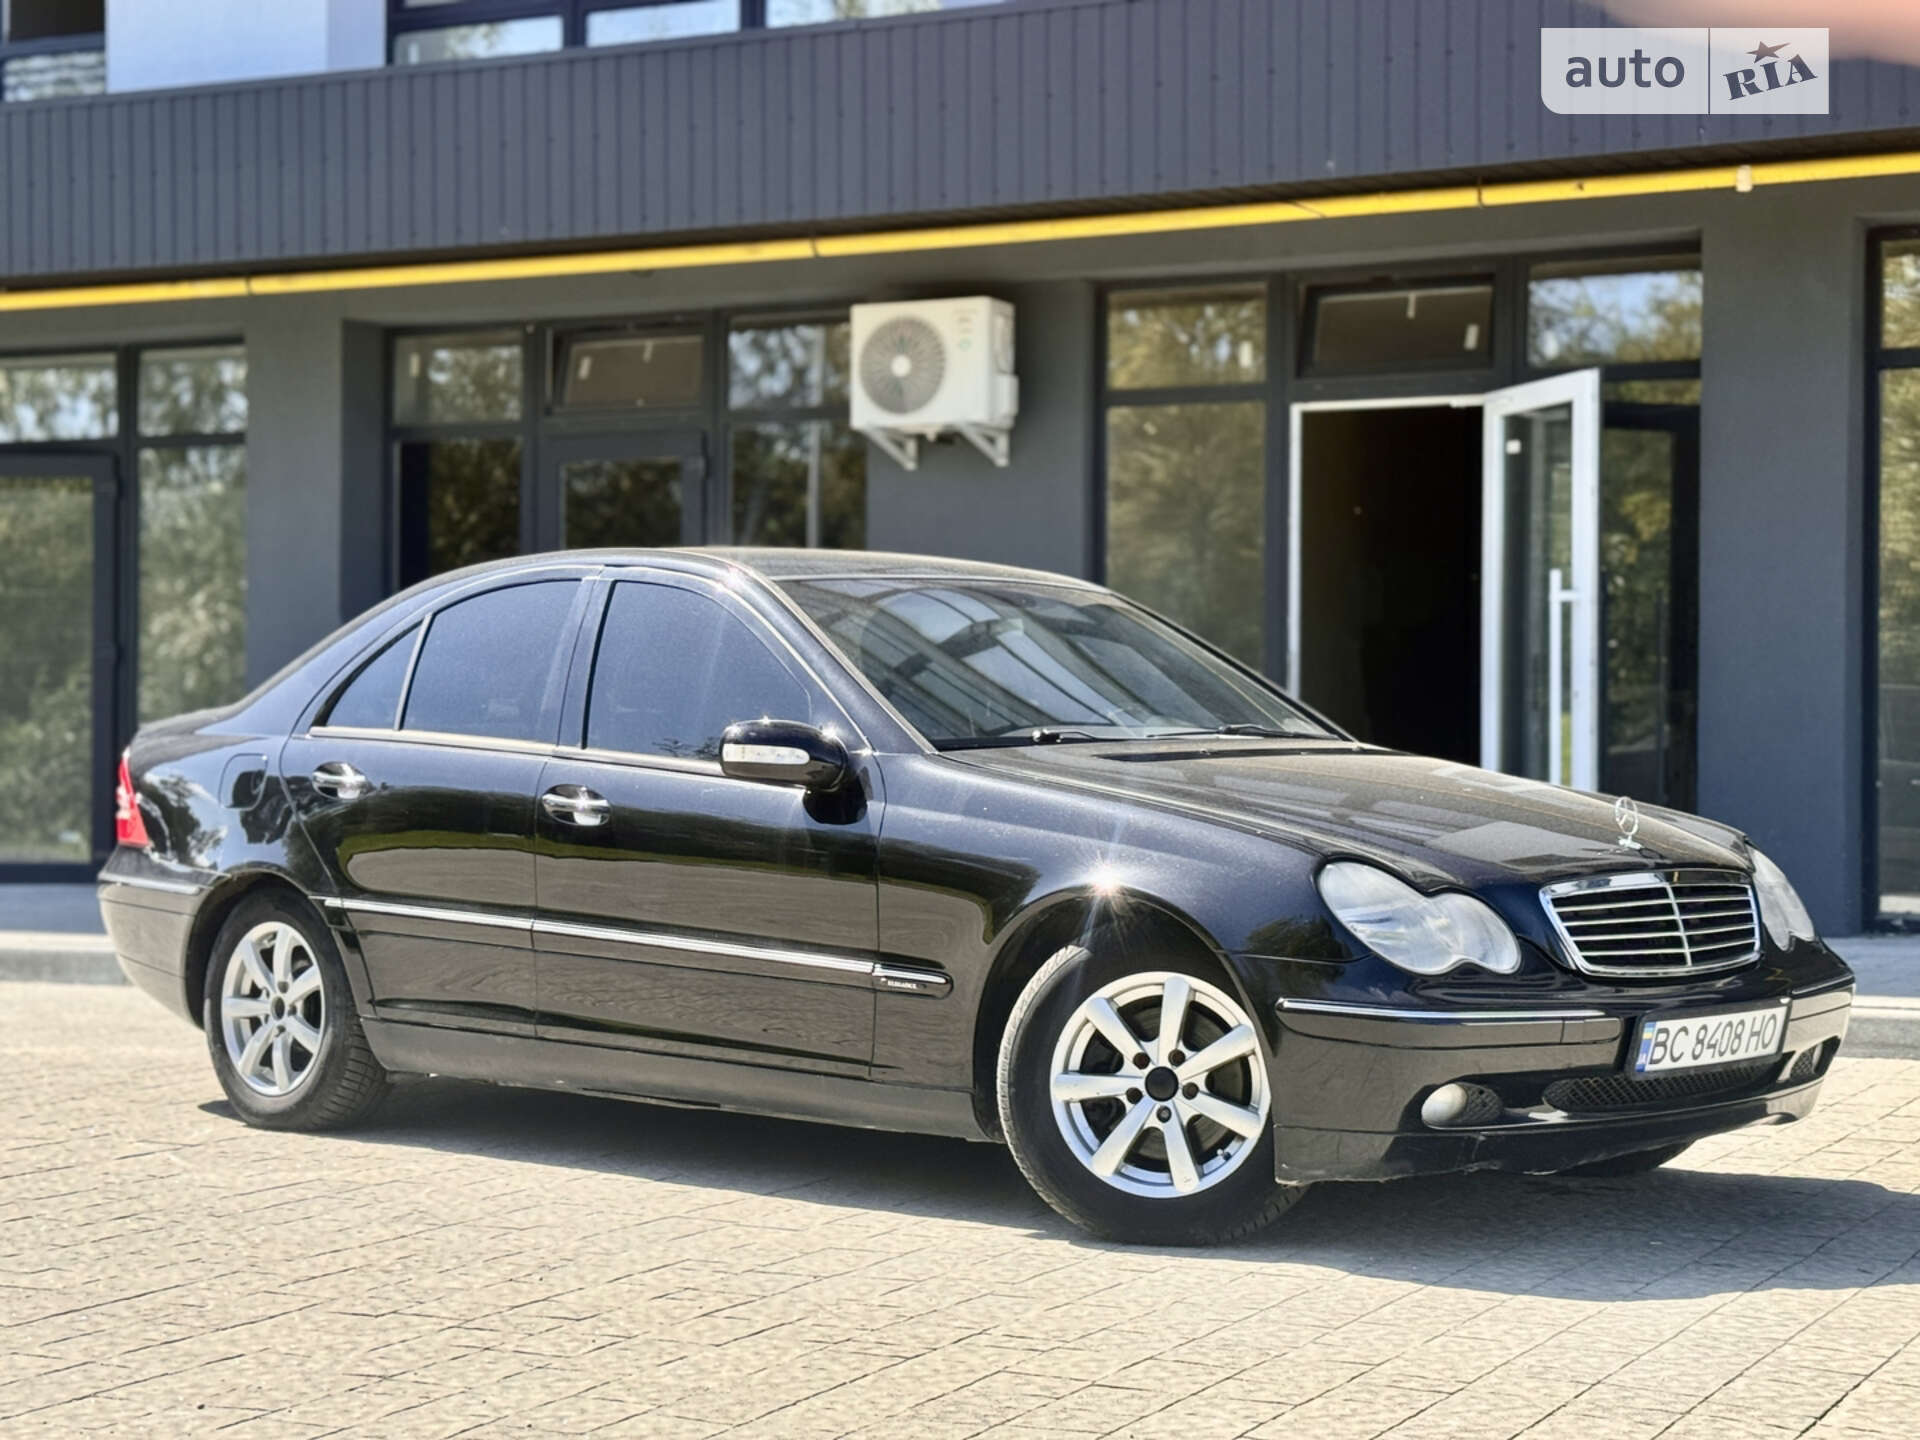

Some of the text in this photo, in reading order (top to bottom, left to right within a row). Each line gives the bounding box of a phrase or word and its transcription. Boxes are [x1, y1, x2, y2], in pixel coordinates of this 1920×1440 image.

[1650, 1013, 1777, 1065] BC 8408 HO
